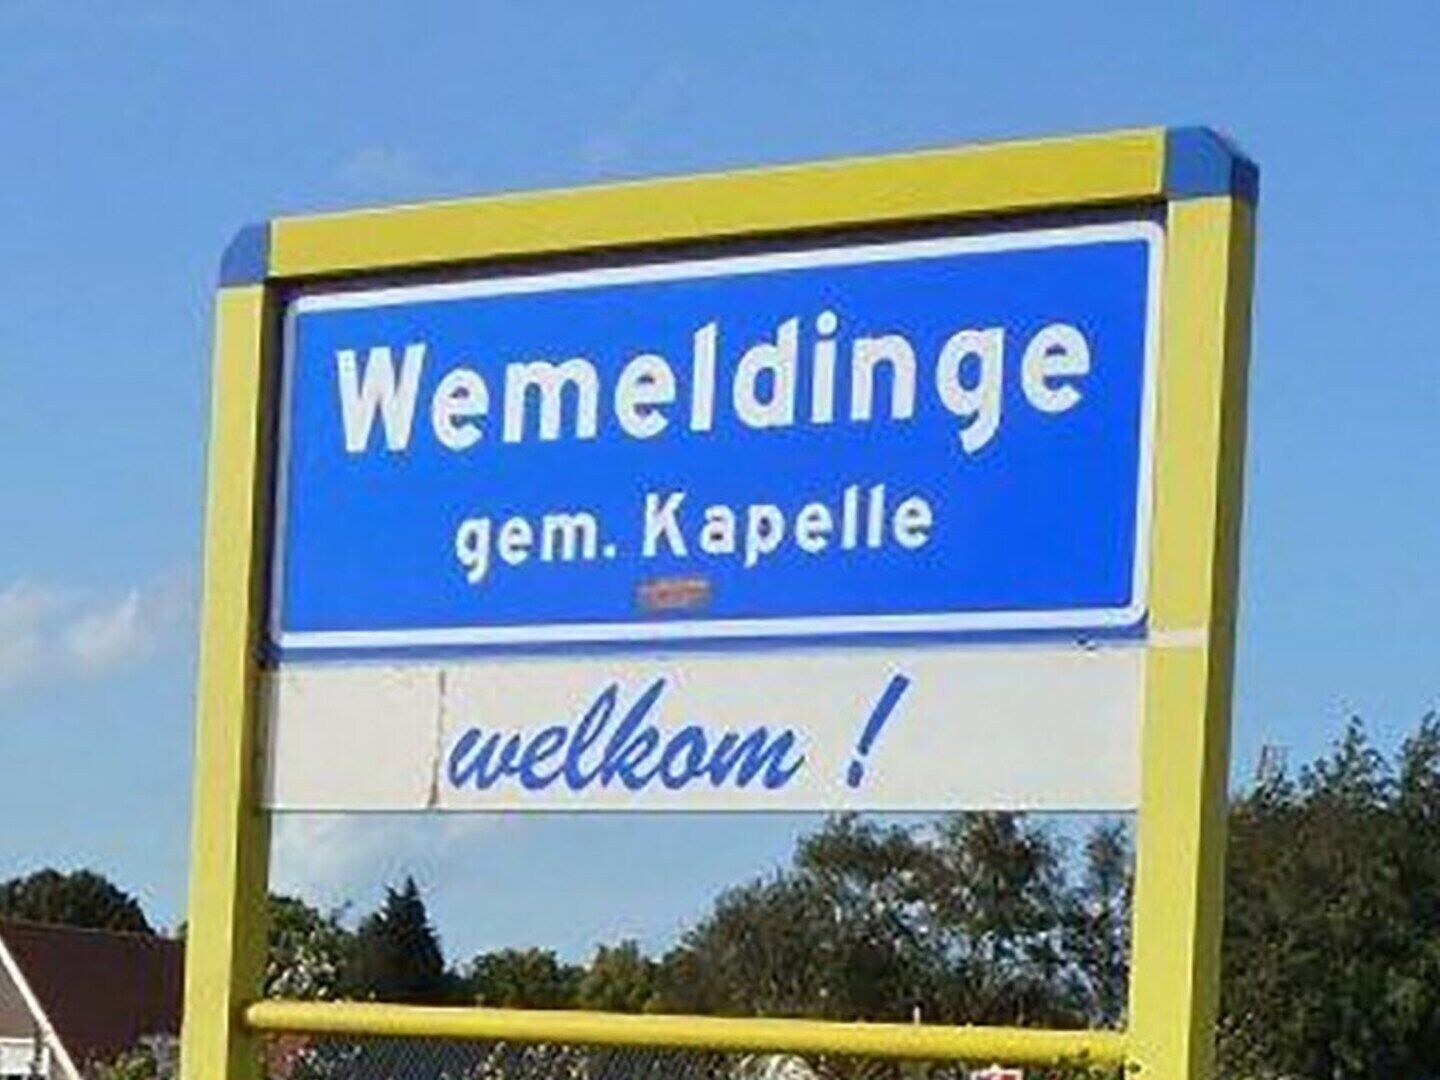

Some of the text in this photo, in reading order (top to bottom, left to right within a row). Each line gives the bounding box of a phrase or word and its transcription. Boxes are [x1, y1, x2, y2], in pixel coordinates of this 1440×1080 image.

[336, 310, 1093, 453] Wemeldinge
[455, 482, 935, 584] gem. Kapelle
[447, 679, 806, 793] welkom
